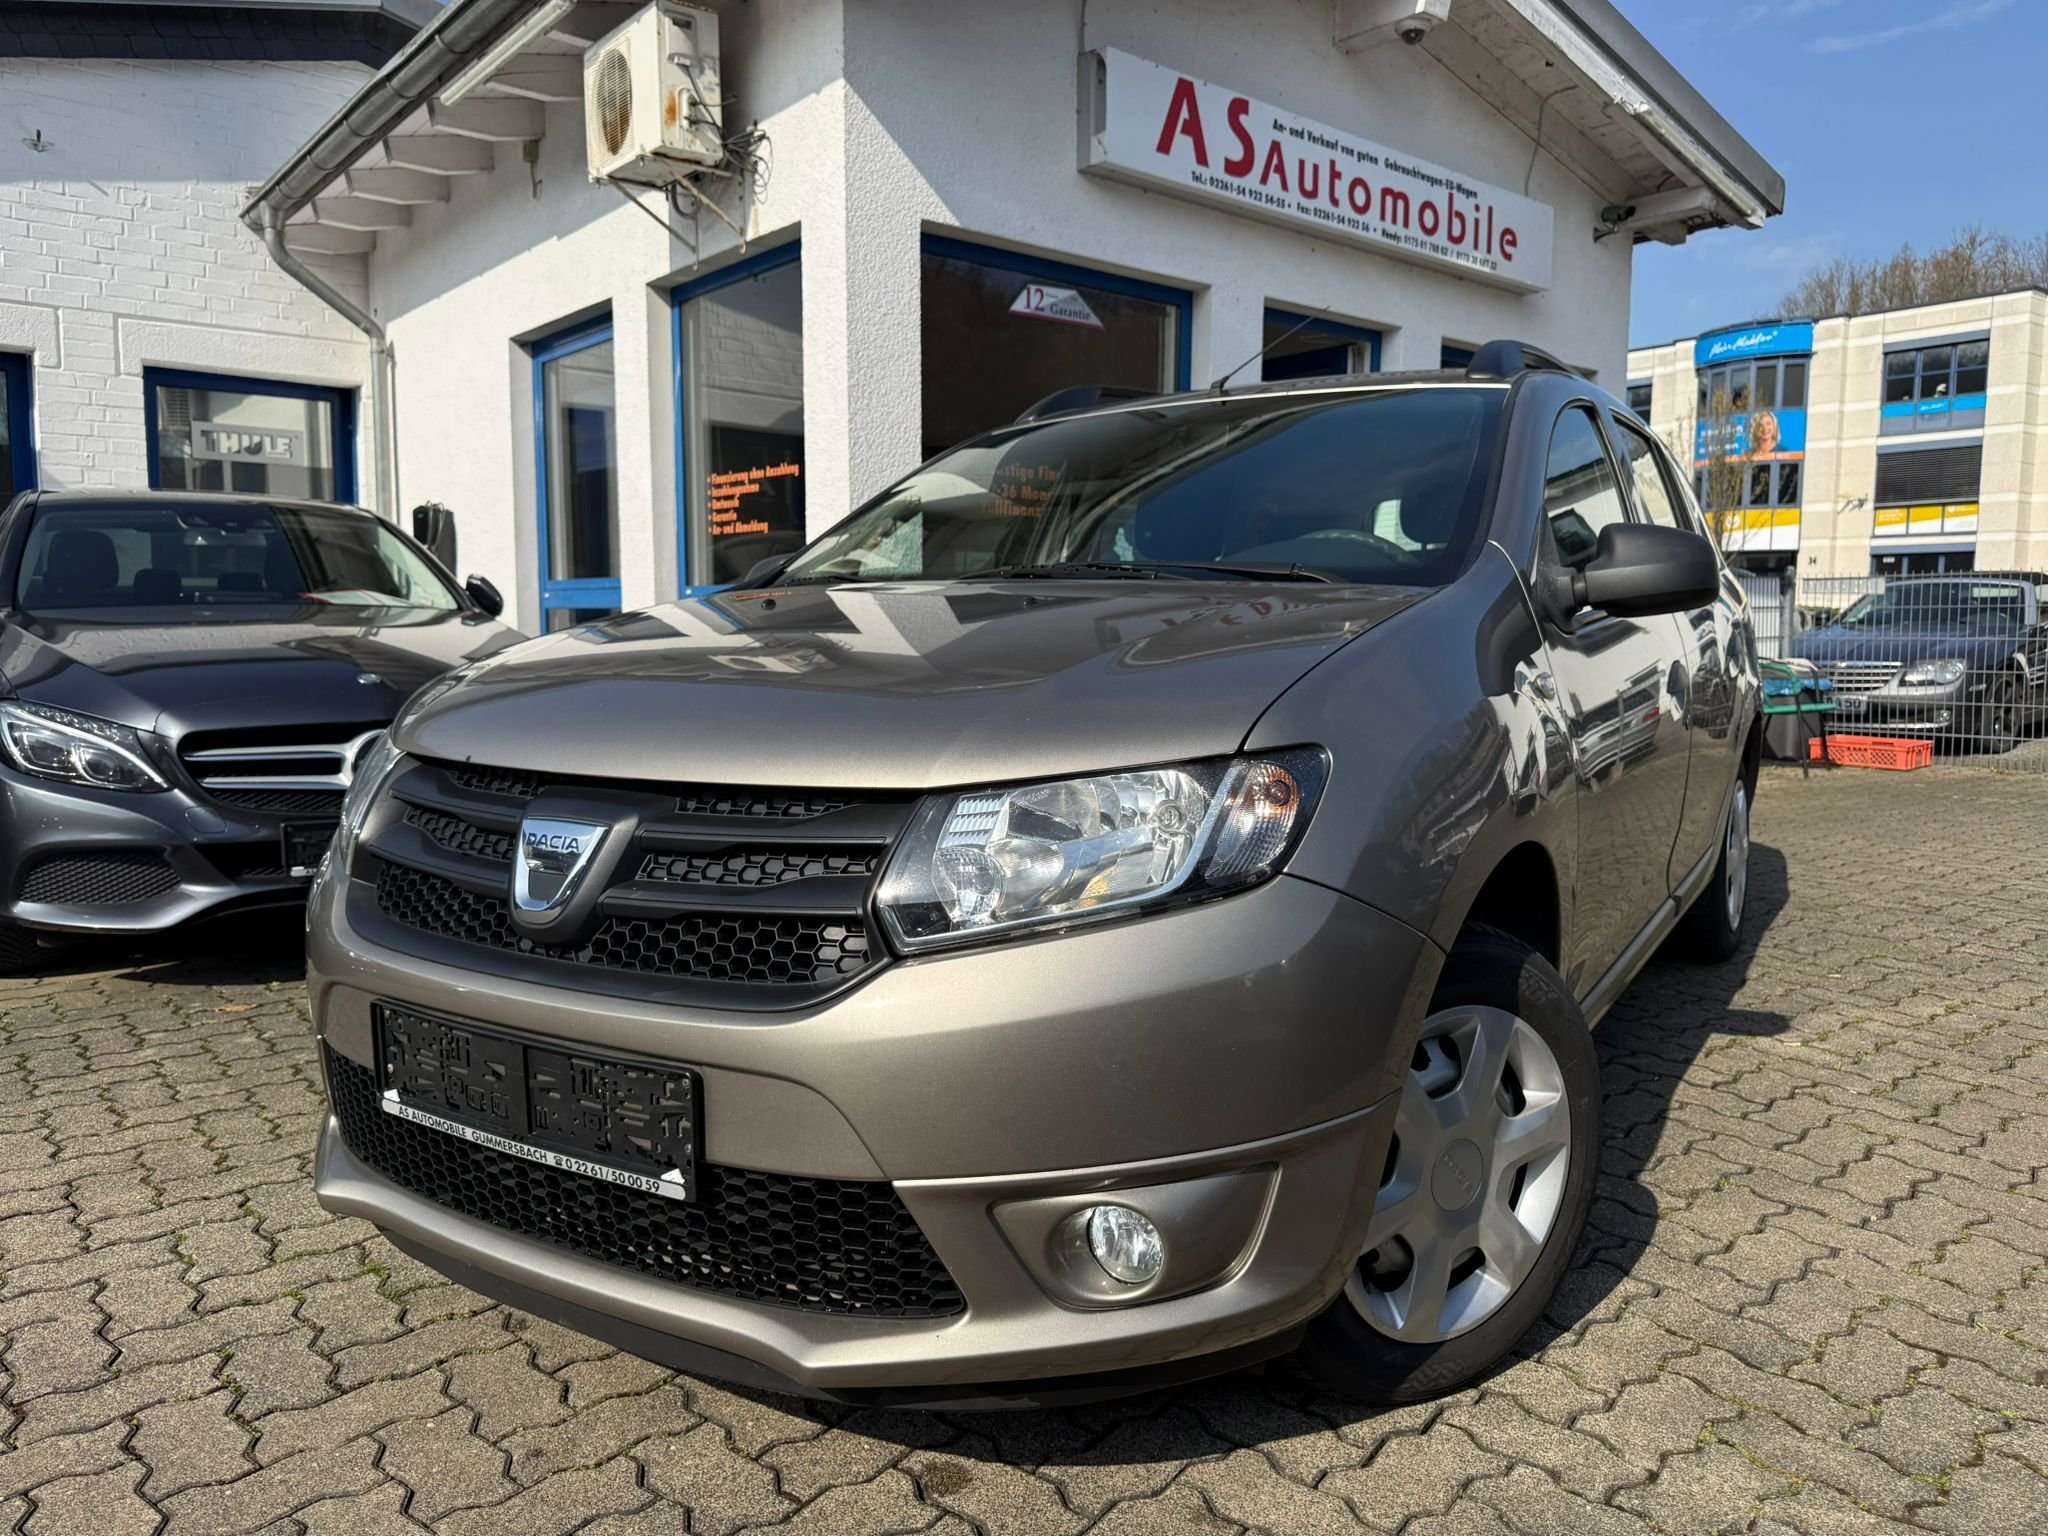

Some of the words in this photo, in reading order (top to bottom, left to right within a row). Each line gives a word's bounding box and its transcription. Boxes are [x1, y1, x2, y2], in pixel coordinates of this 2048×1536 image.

[1289, 127, 1305, 140] und
[1306, 129, 1339, 152] Verkauf
[1024, 286, 1045, 312] 12
[1049, 303, 1091, 321] Garantie
[200, 429, 294, 459] THULE
[526, 832, 581, 852] DACIA
[399, 1105, 410, 1118] AS
[412, 1109, 467, 1138] AUTOMOBILE
[471, 1130, 549, 1163] GUMMERSBACH
